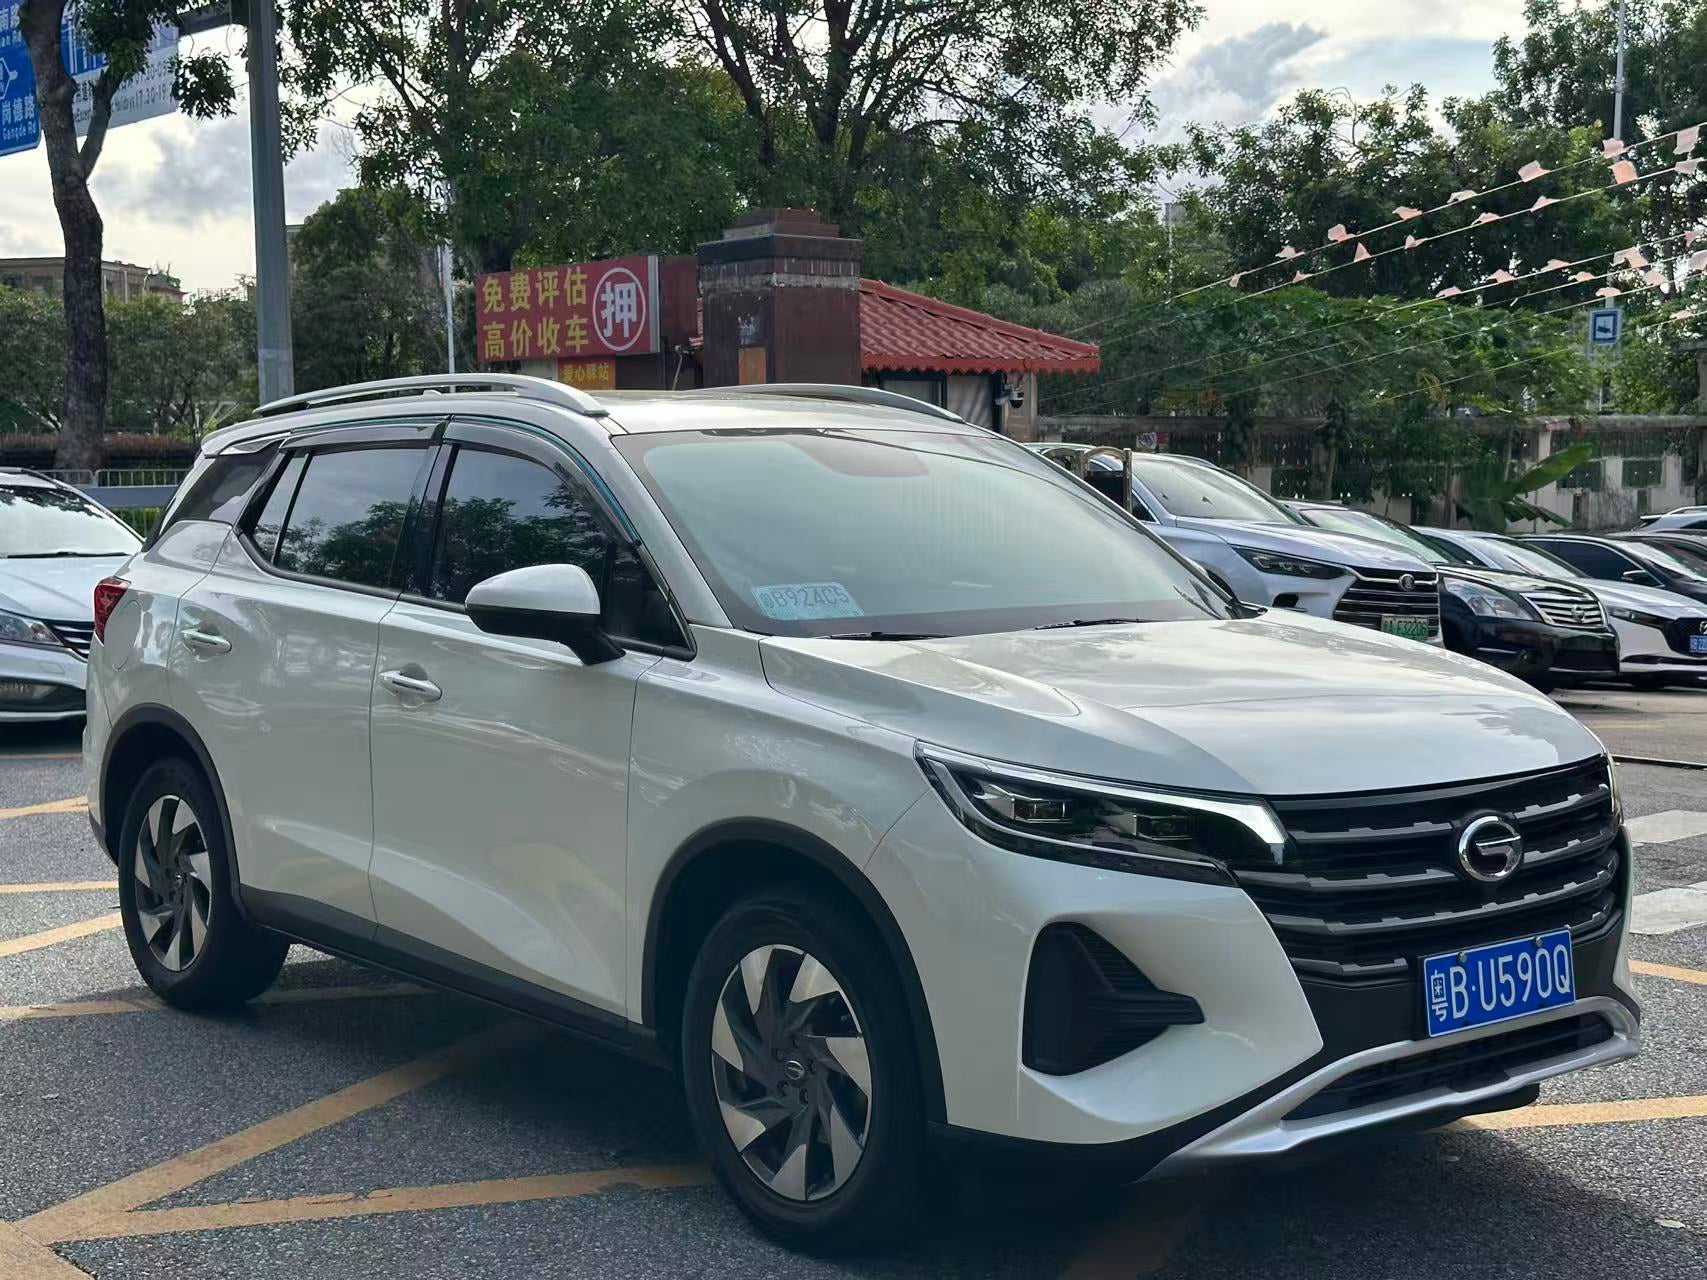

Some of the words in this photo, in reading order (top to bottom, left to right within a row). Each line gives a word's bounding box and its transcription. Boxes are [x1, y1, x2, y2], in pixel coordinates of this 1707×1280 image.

[2, 94, 35, 125] 岗德路
[27, 120, 37, 135] Rd
[482, 266, 588, 314] 免费评估
[600, 281, 638, 338] 押
[483, 314, 589, 359] 高价收车
